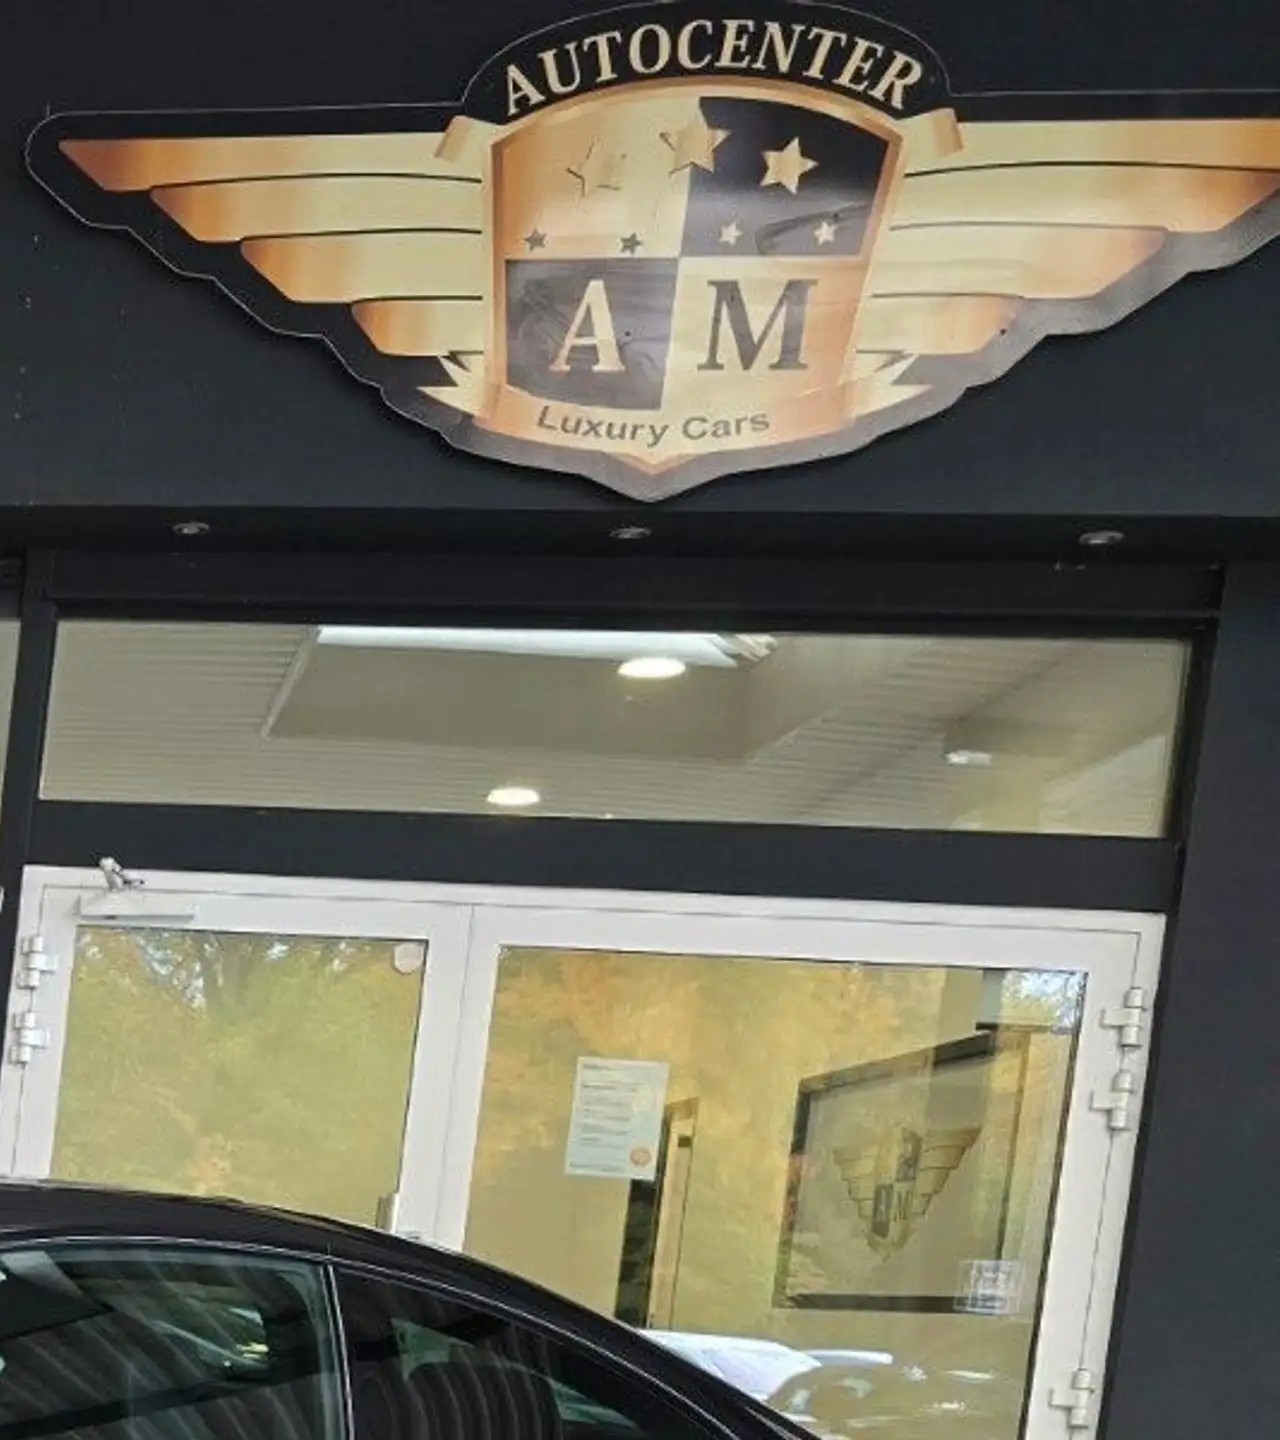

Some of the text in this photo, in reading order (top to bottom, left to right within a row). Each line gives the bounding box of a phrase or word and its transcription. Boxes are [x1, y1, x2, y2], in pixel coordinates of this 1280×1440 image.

[505, 19, 924, 117] AUTOCENTER
[549, 279, 820, 372] A M
[537, 405, 771, 448] Luxury Cars
